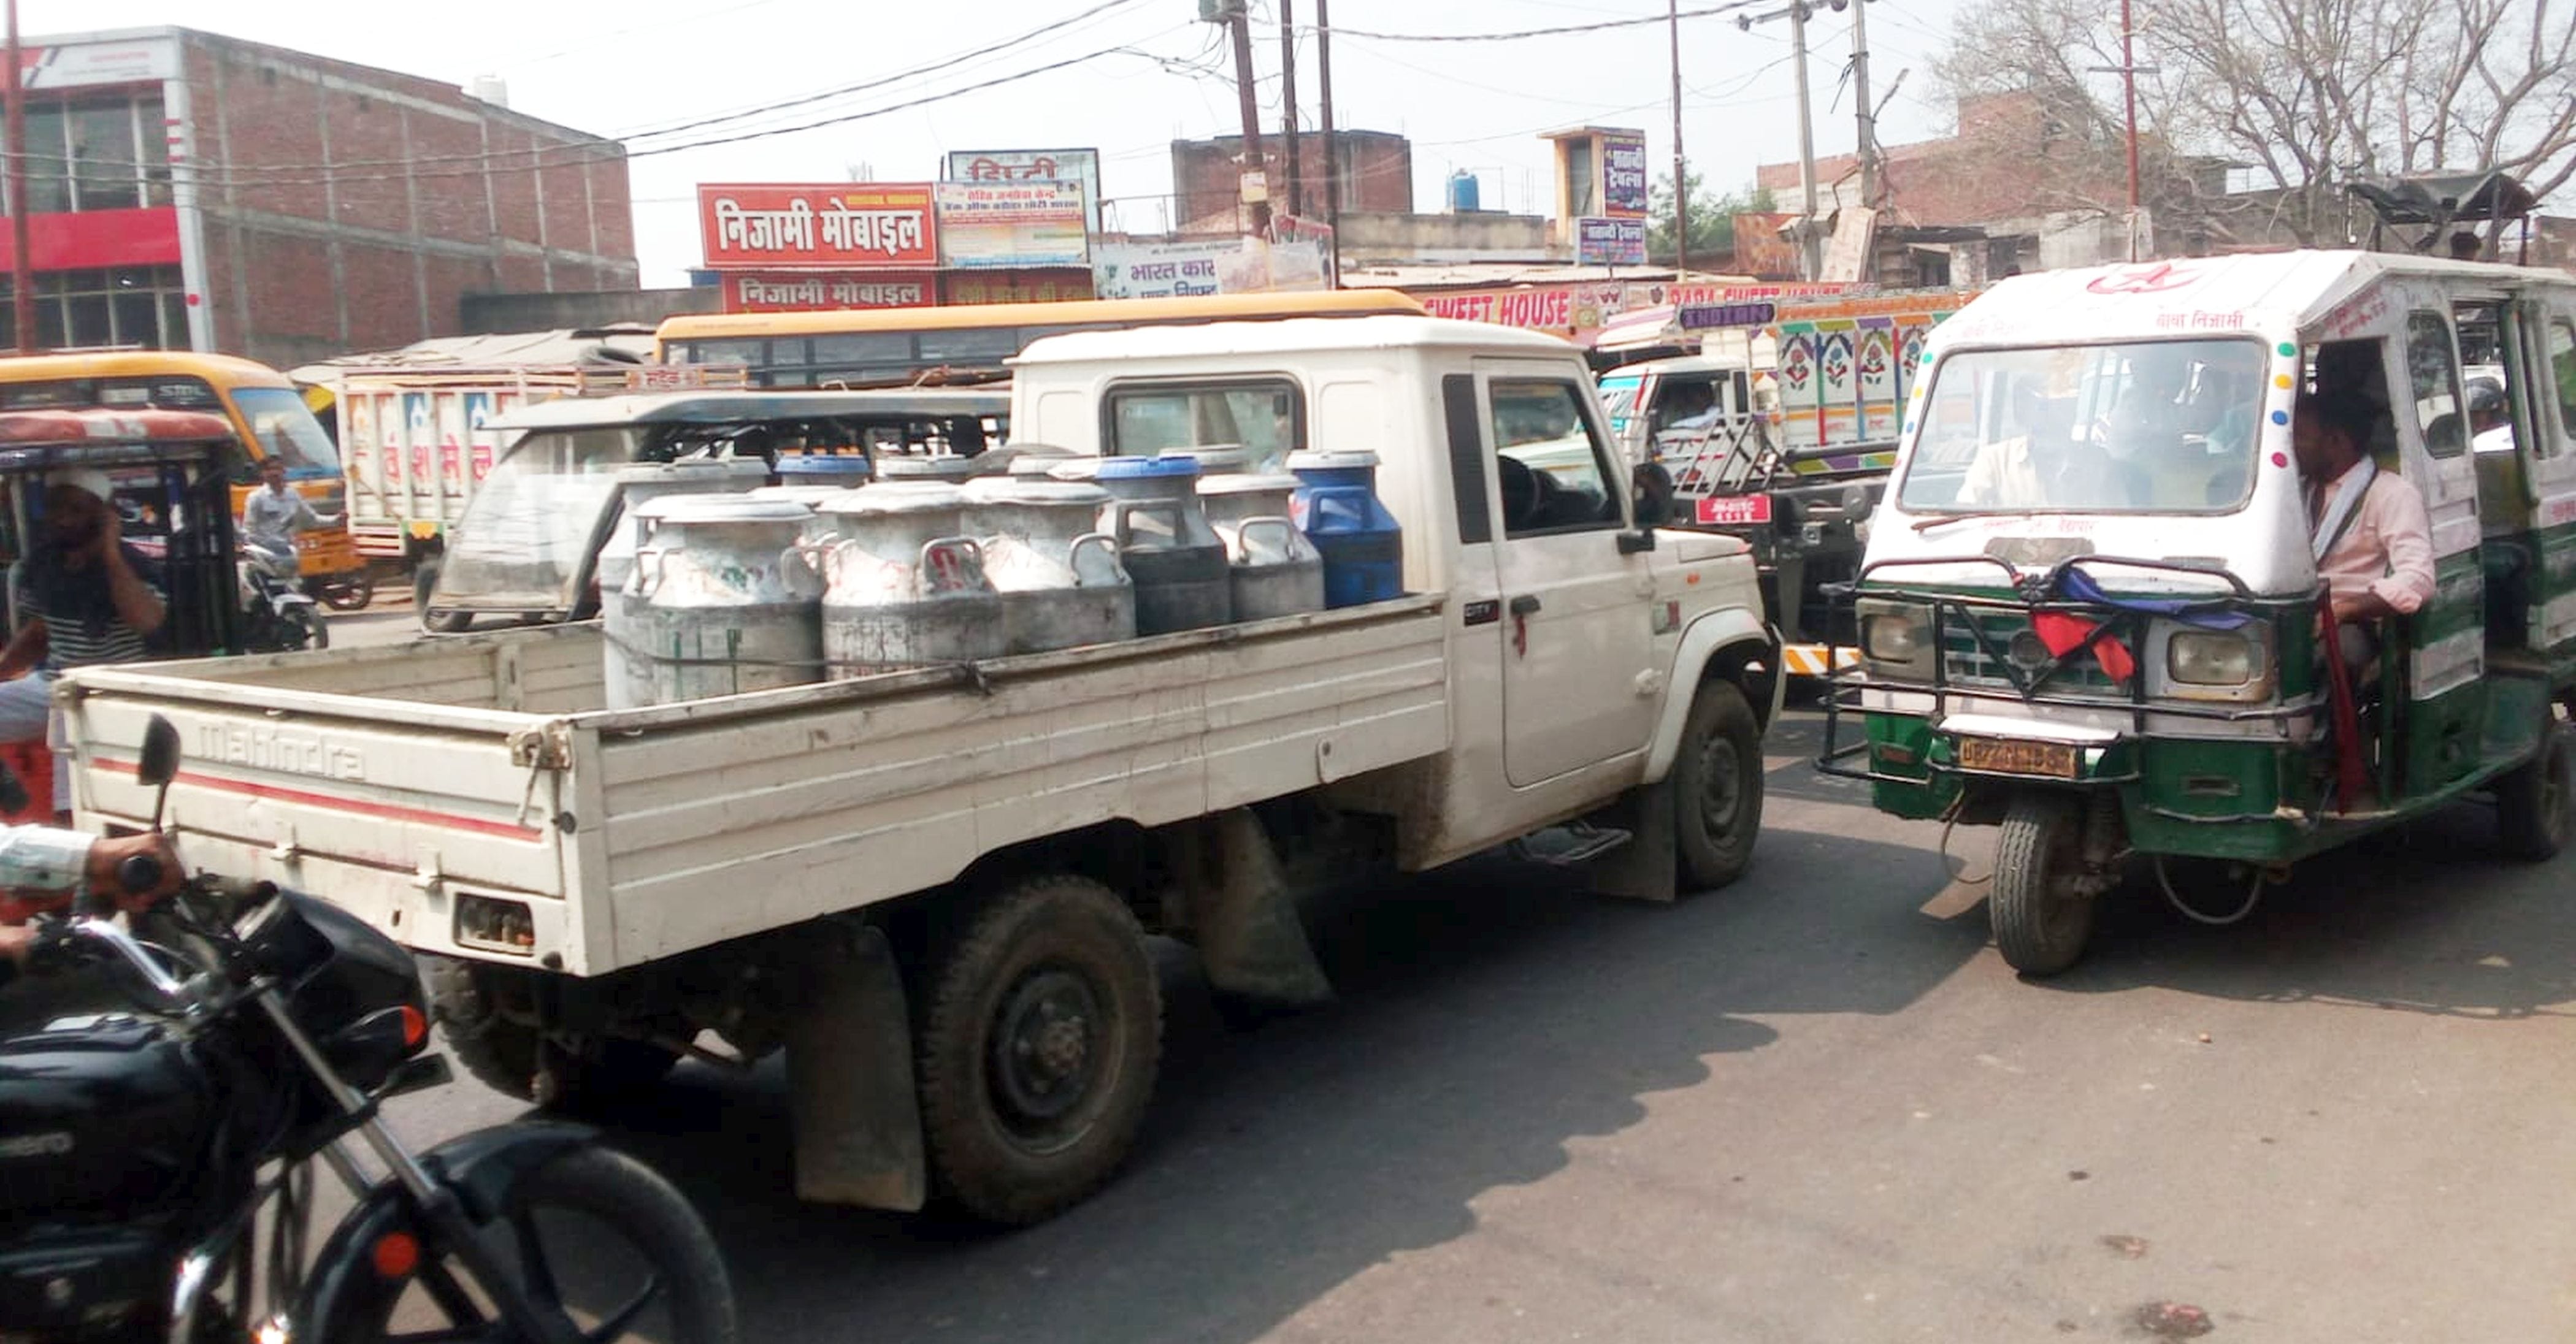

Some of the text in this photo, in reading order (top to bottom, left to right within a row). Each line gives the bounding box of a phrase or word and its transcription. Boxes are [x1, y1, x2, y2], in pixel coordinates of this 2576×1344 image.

[715, 197, 923, 256] निजामी मोबाइल
[1130, 262, 1176, 281] भारत
[740, 278, 827, 305] निजामी
[832, 280, 922, 306] मोबाइल
[1500, 291, 1570, 327] HOUSE
